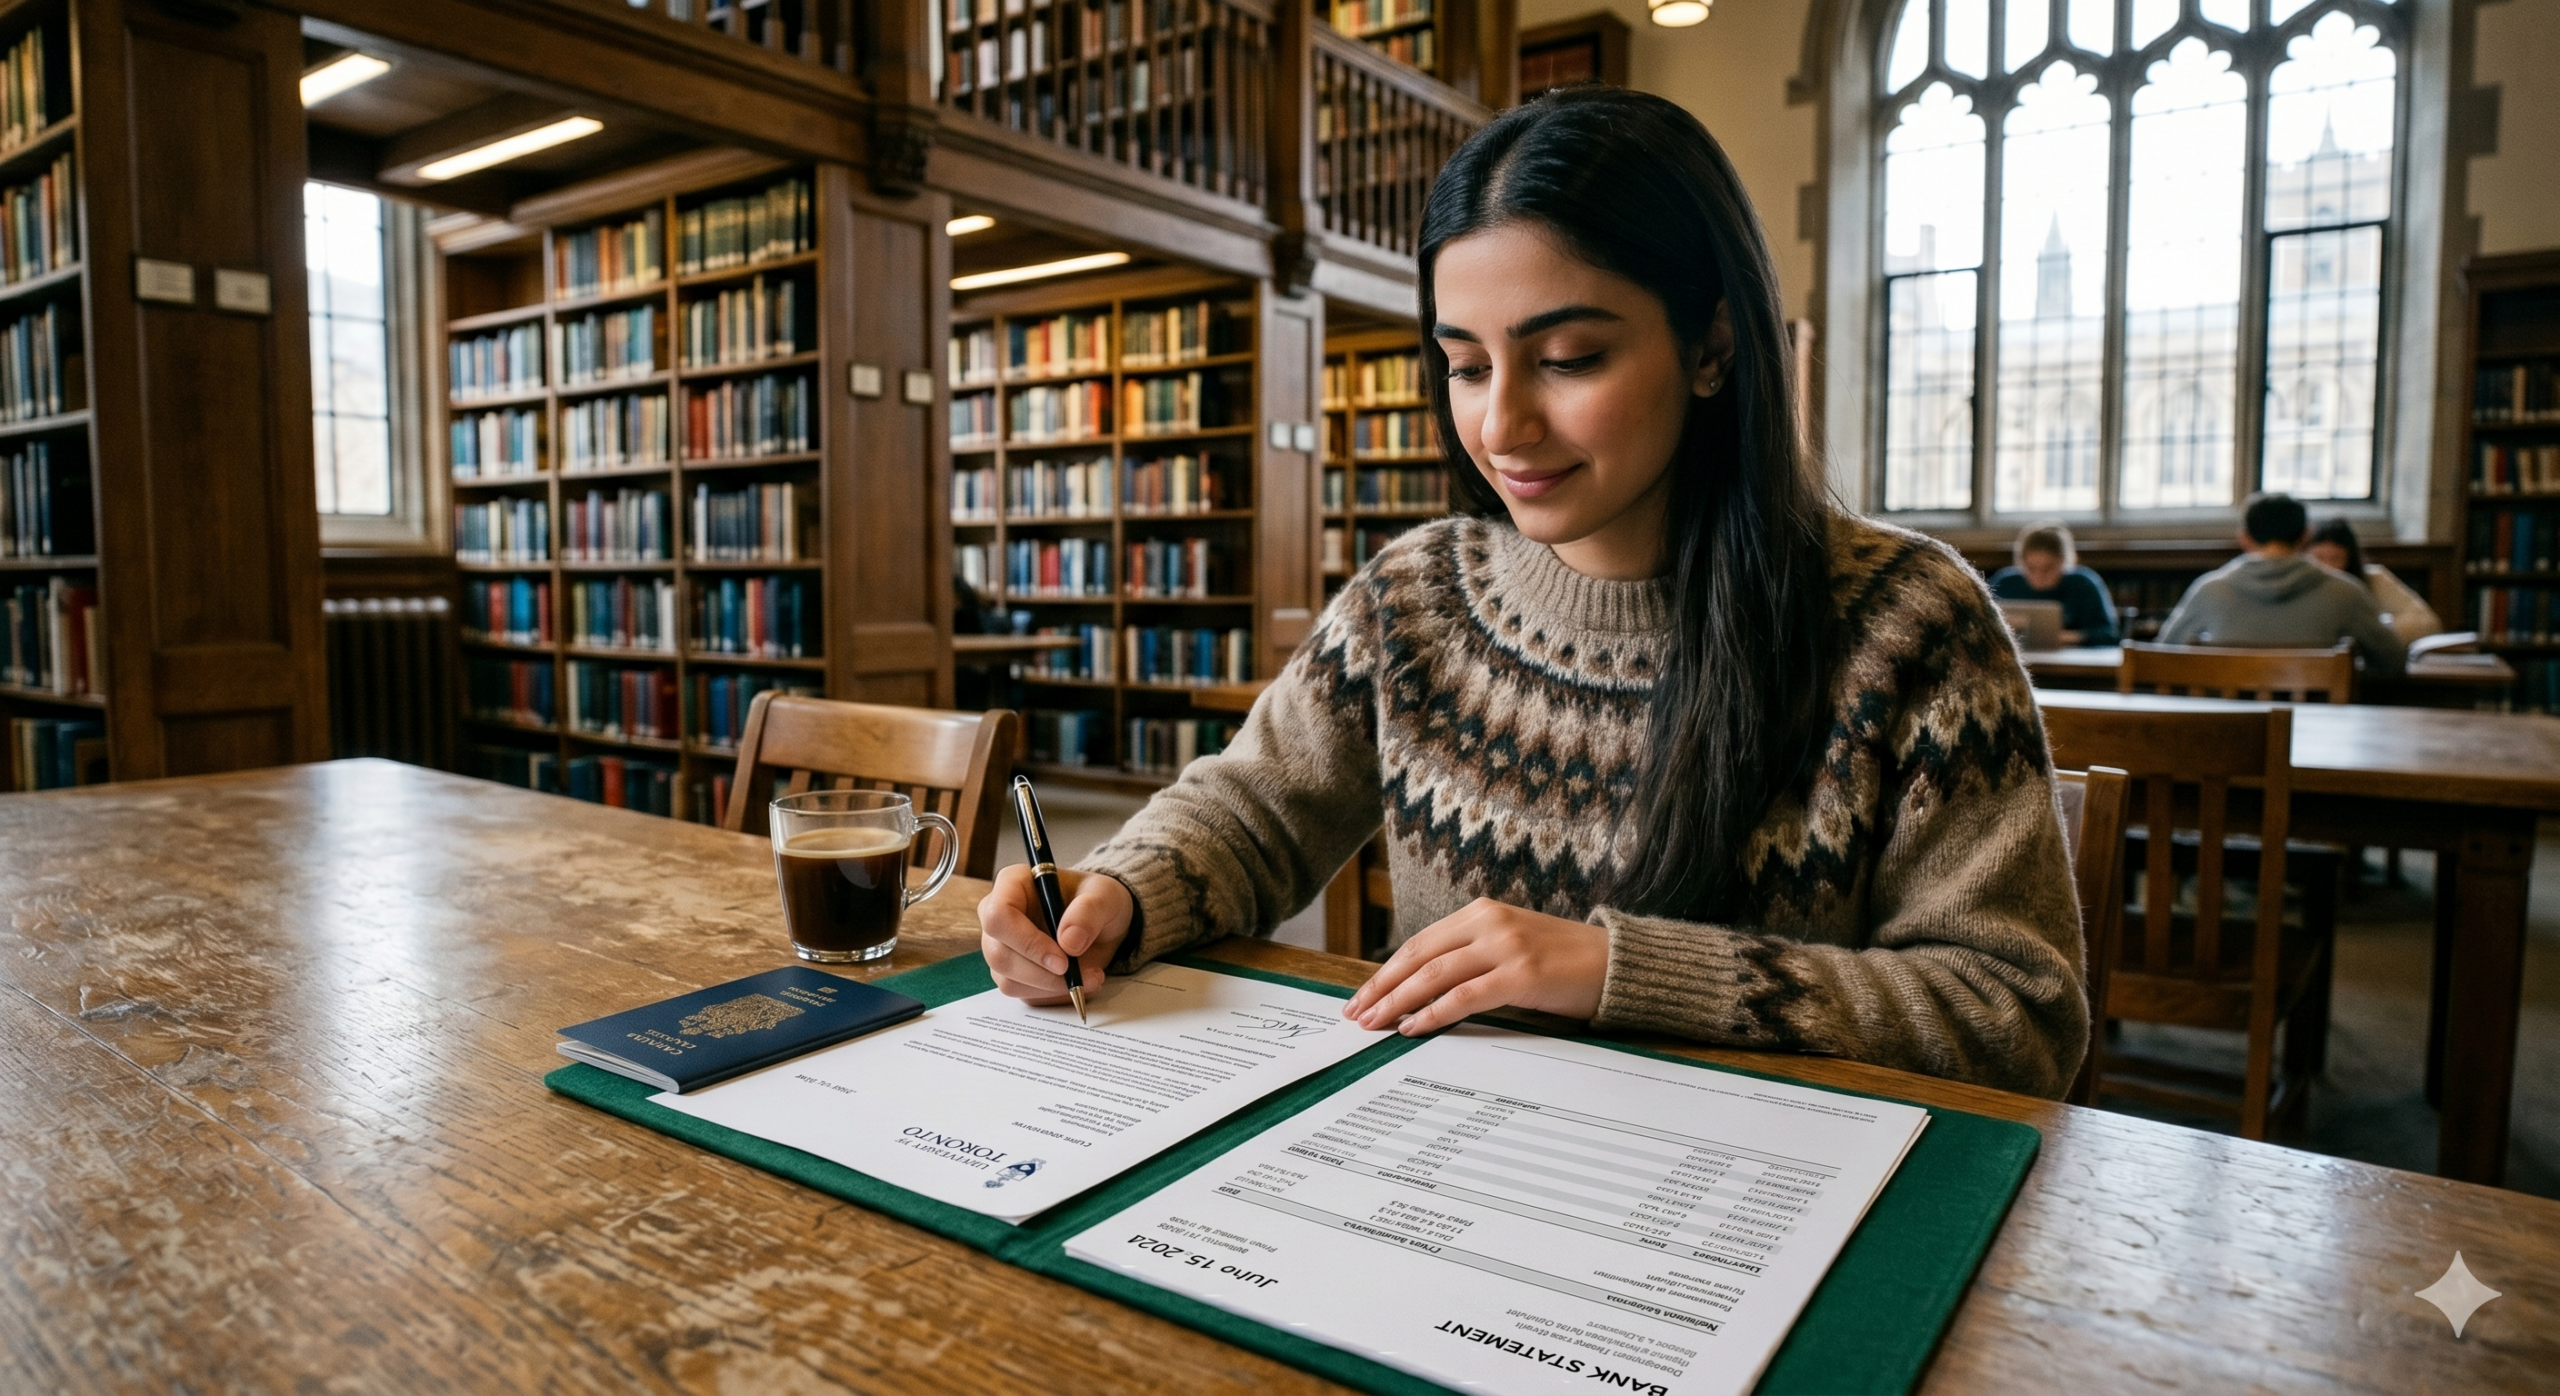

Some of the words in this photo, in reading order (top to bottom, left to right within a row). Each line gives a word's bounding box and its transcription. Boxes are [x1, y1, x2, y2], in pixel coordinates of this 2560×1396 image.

[902, 1126, 1008, 1163] TORONTO
[1127, 1234, 1185, 1258] 2024
[1434, 1320, 1585, 1373] STATEMENT
[1586, 1366, 1669, 1396] BANK
